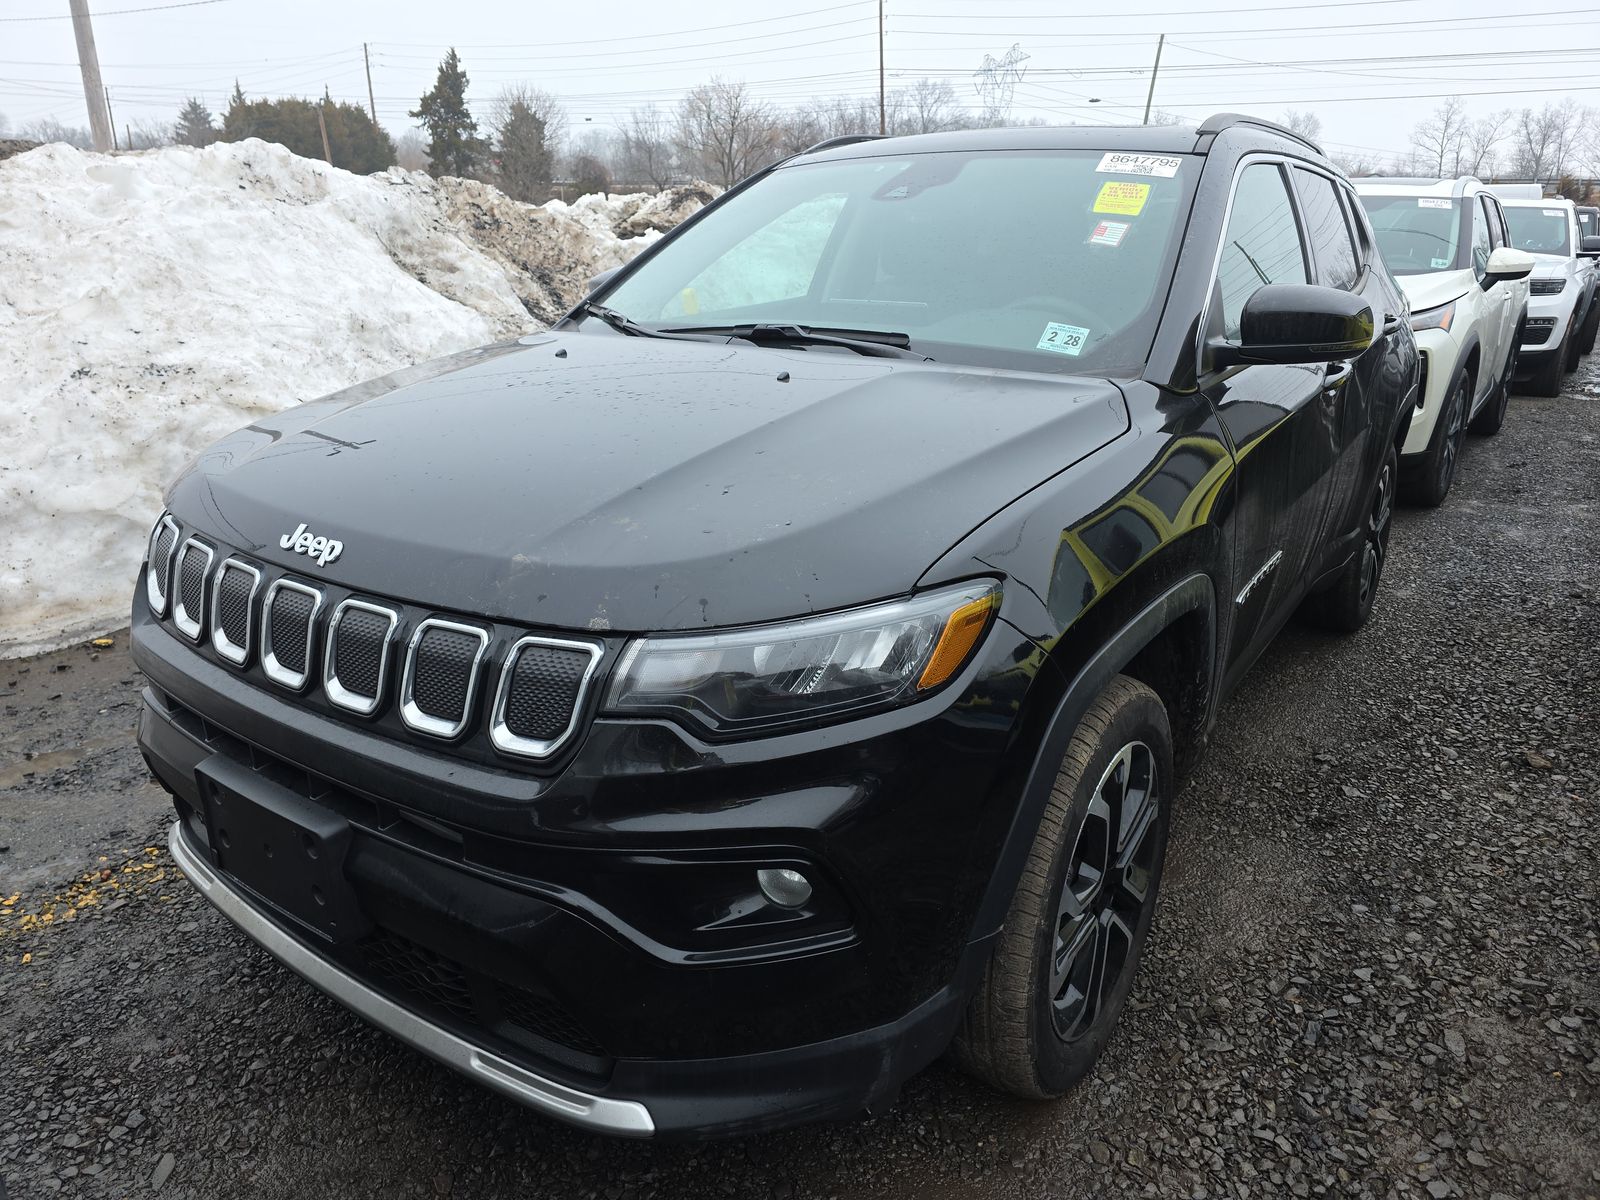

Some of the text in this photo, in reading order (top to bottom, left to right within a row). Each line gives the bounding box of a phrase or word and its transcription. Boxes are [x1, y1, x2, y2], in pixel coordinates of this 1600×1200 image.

[1110, 154, 1180, 168] 8647795
[1047, 331, 1058, 342] 2
[1063, 334, 1081, 347] 28
[280, 523, 344, 568] Jeep
